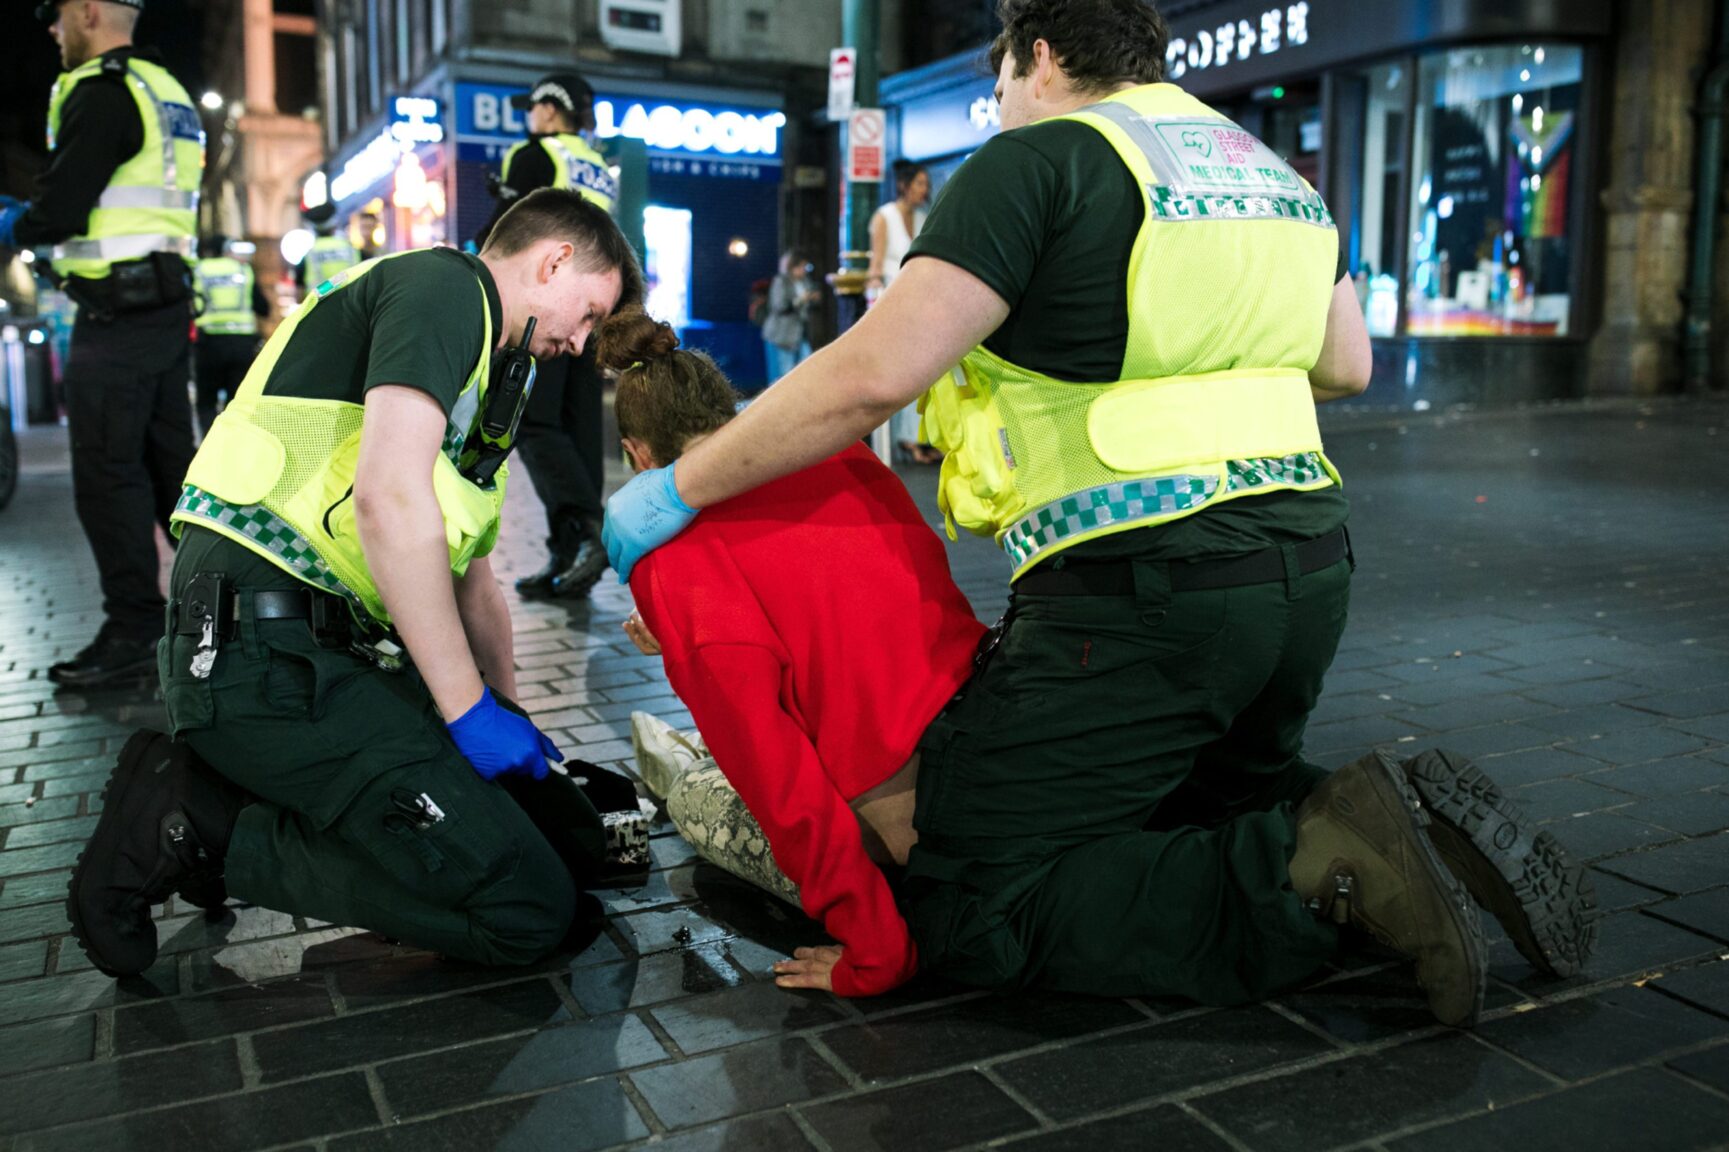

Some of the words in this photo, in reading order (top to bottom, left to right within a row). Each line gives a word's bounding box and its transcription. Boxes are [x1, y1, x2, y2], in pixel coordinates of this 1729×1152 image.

[1219, 141, 1255, 153] STREET
[1227, 153, 1246, 164] AID
[1189, 165, 1255, 181] MEDICAL
[1255, 167, 1293, 184] TEAM
